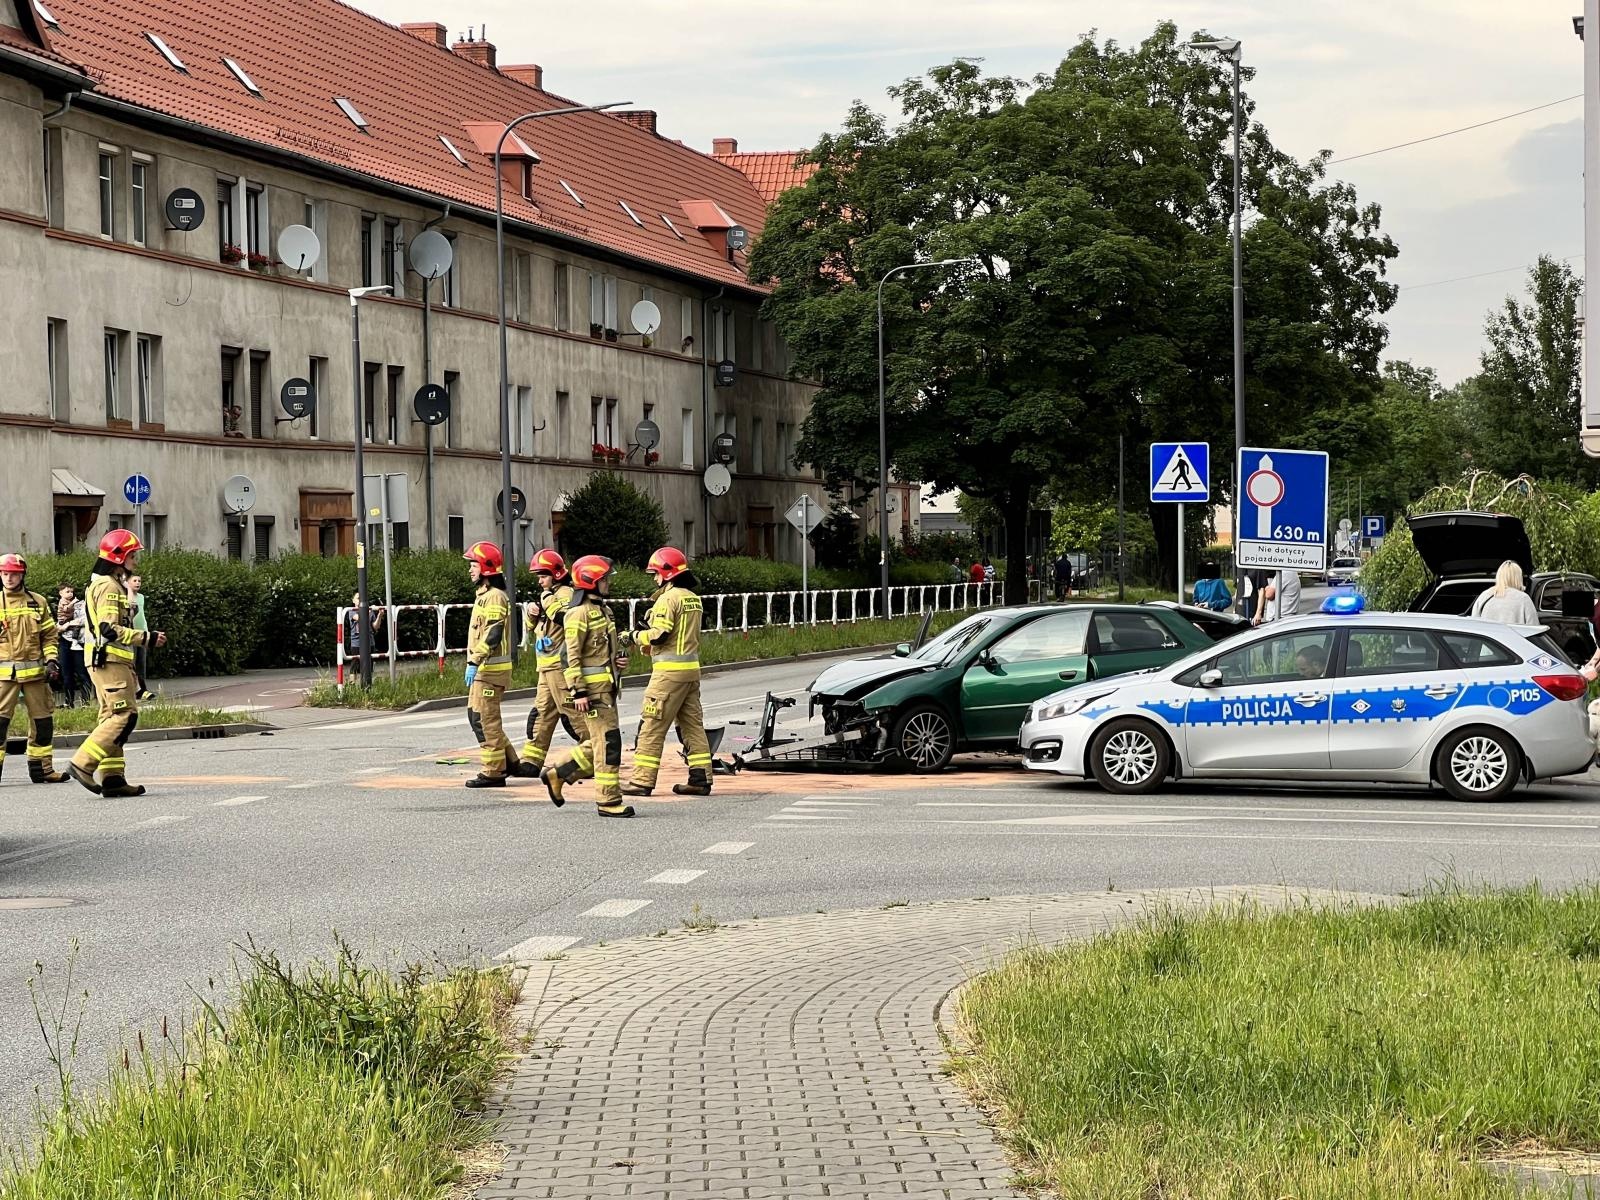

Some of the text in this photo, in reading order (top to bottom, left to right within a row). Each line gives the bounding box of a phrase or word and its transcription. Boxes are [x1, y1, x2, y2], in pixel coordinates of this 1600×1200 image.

[1273, 525, 1320, 541] 630 m
[1367, 518, 1380, 535] P
[1274, 547, 1306, 556] dotyczy
[1287, 557, 1319, 567] budowy
[1510, 689, 1541, 702] P105
[1222, 700, 1293, 720] POLICJA
